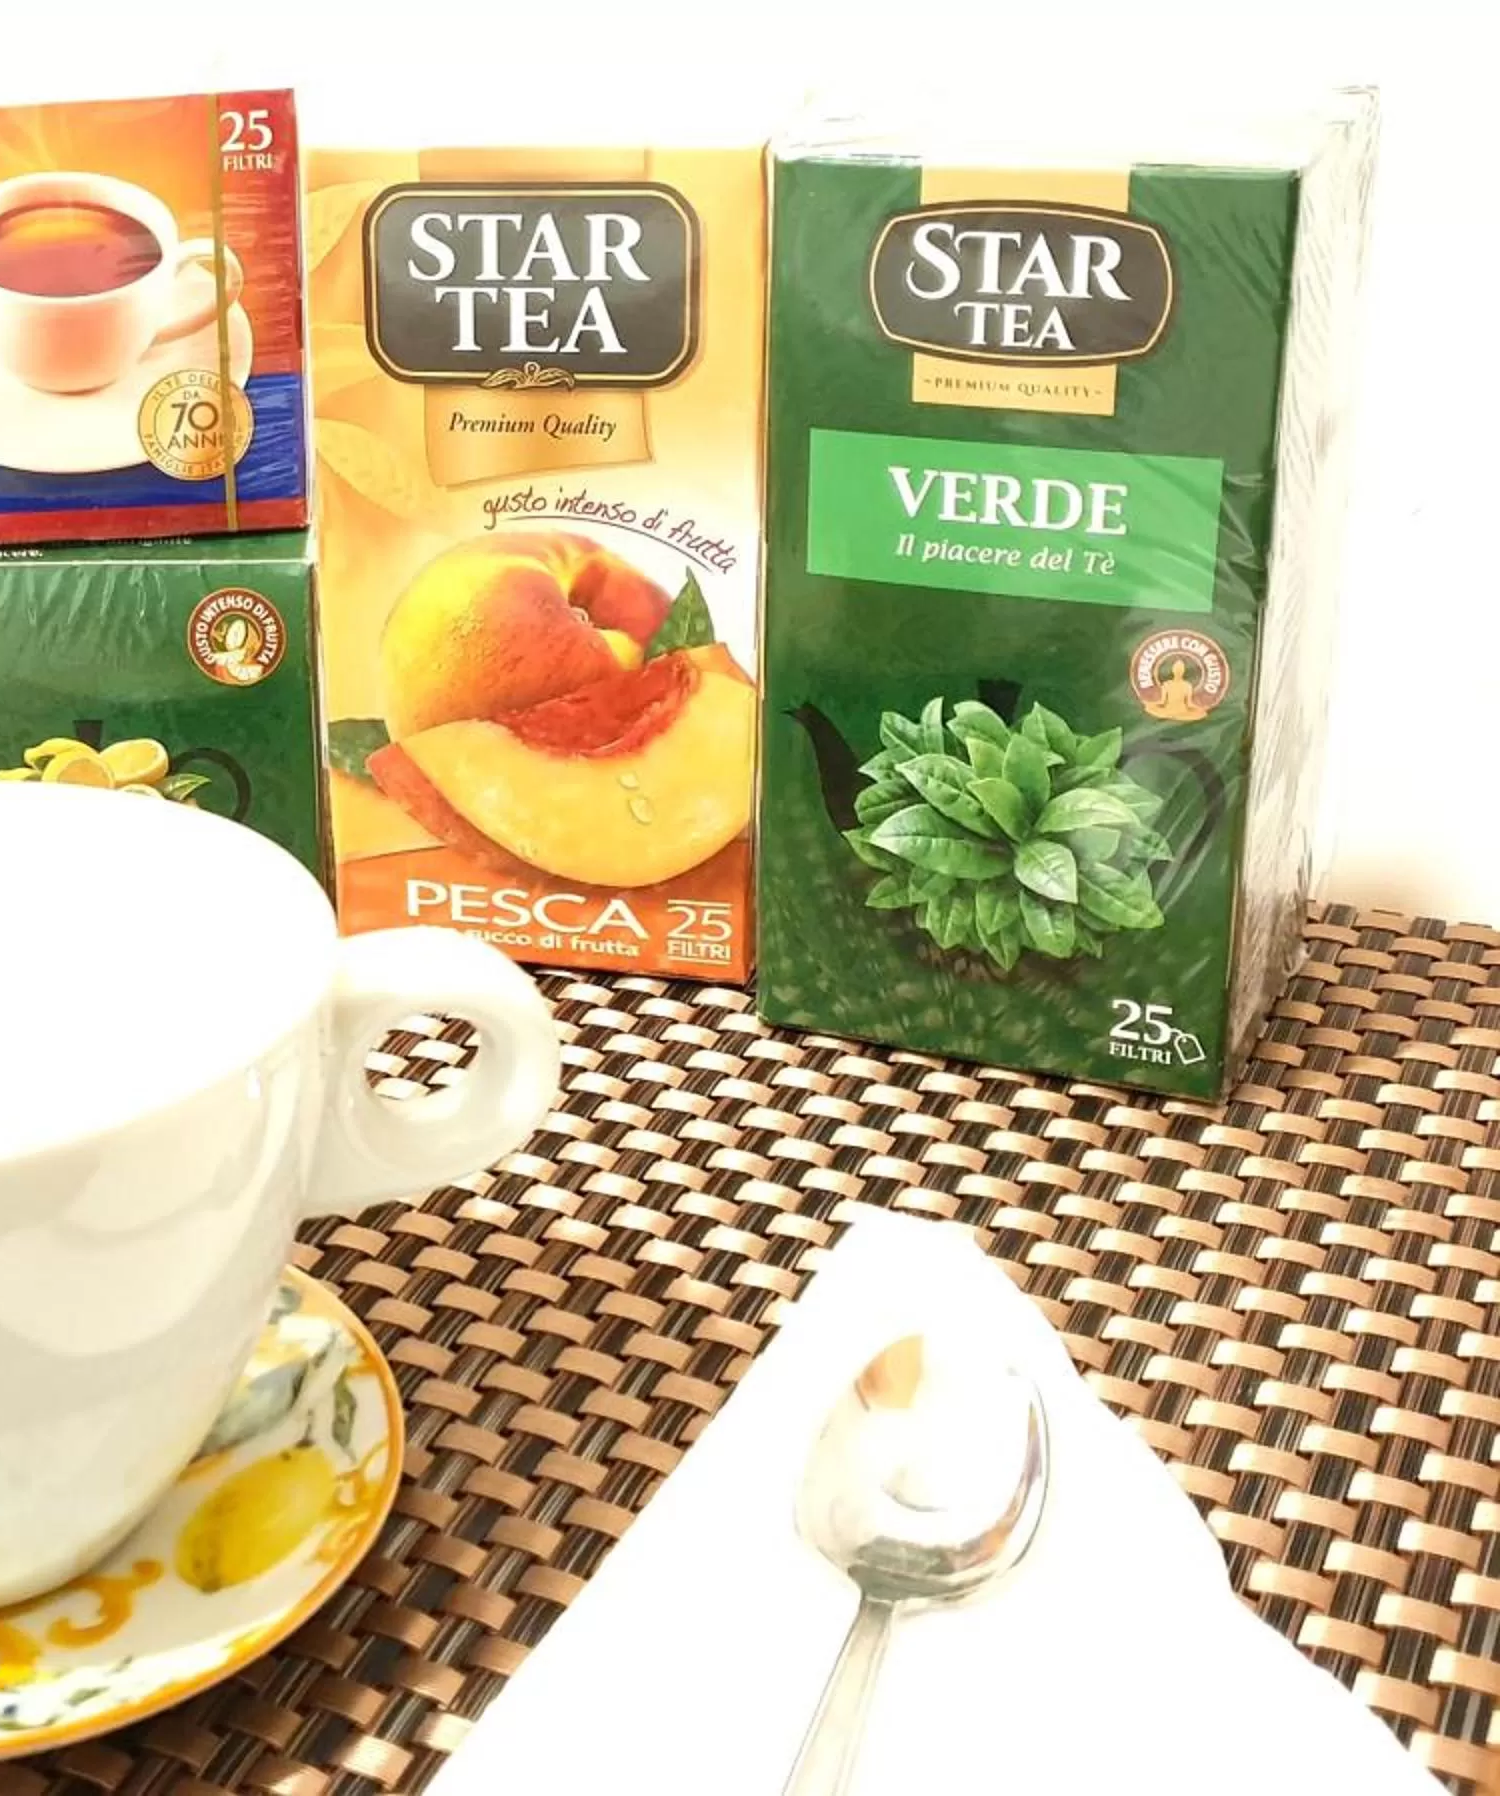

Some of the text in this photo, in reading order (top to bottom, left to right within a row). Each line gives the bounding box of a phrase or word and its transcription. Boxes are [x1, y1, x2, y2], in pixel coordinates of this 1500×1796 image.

[220, 110, 272, 152] 25
[223, 154, 272, 172] FILTRI
[408, 212, 651, 283] STAR
[905, 222, 1132, 300] STAR
[435, 286, 627, 353] TEA
[954, 302, 1076, 350] TEA
[183, 391, 200, 400] DA
[935, 377, 1091, 398] PREMIUM QUALITY
[171, 401, 218, 432] 70
[449, 412, 616, 441] Premium Quality
[168, 434, 223, 449] ANNI
[888, 466, 1127, 535] VERDE
[483, 486, 737, 574] gusto intenso di frutta
[896, 533, 1115, 575] Il piacere del Tè
[196, 595, 278, 664] GUSTO INTENSO DI FRUTTA
[406, 879, 648, 940] PESCA
[666, 905, 733, 942] 25
[540, 929, 562, 949] di
[571, 932, 640, 957] frutta
[667, 942, 731, 959] FILTRI
[1110, 999, 1172, 1044] 25
[1109, 1041, 1171, 1064] FILTRI
